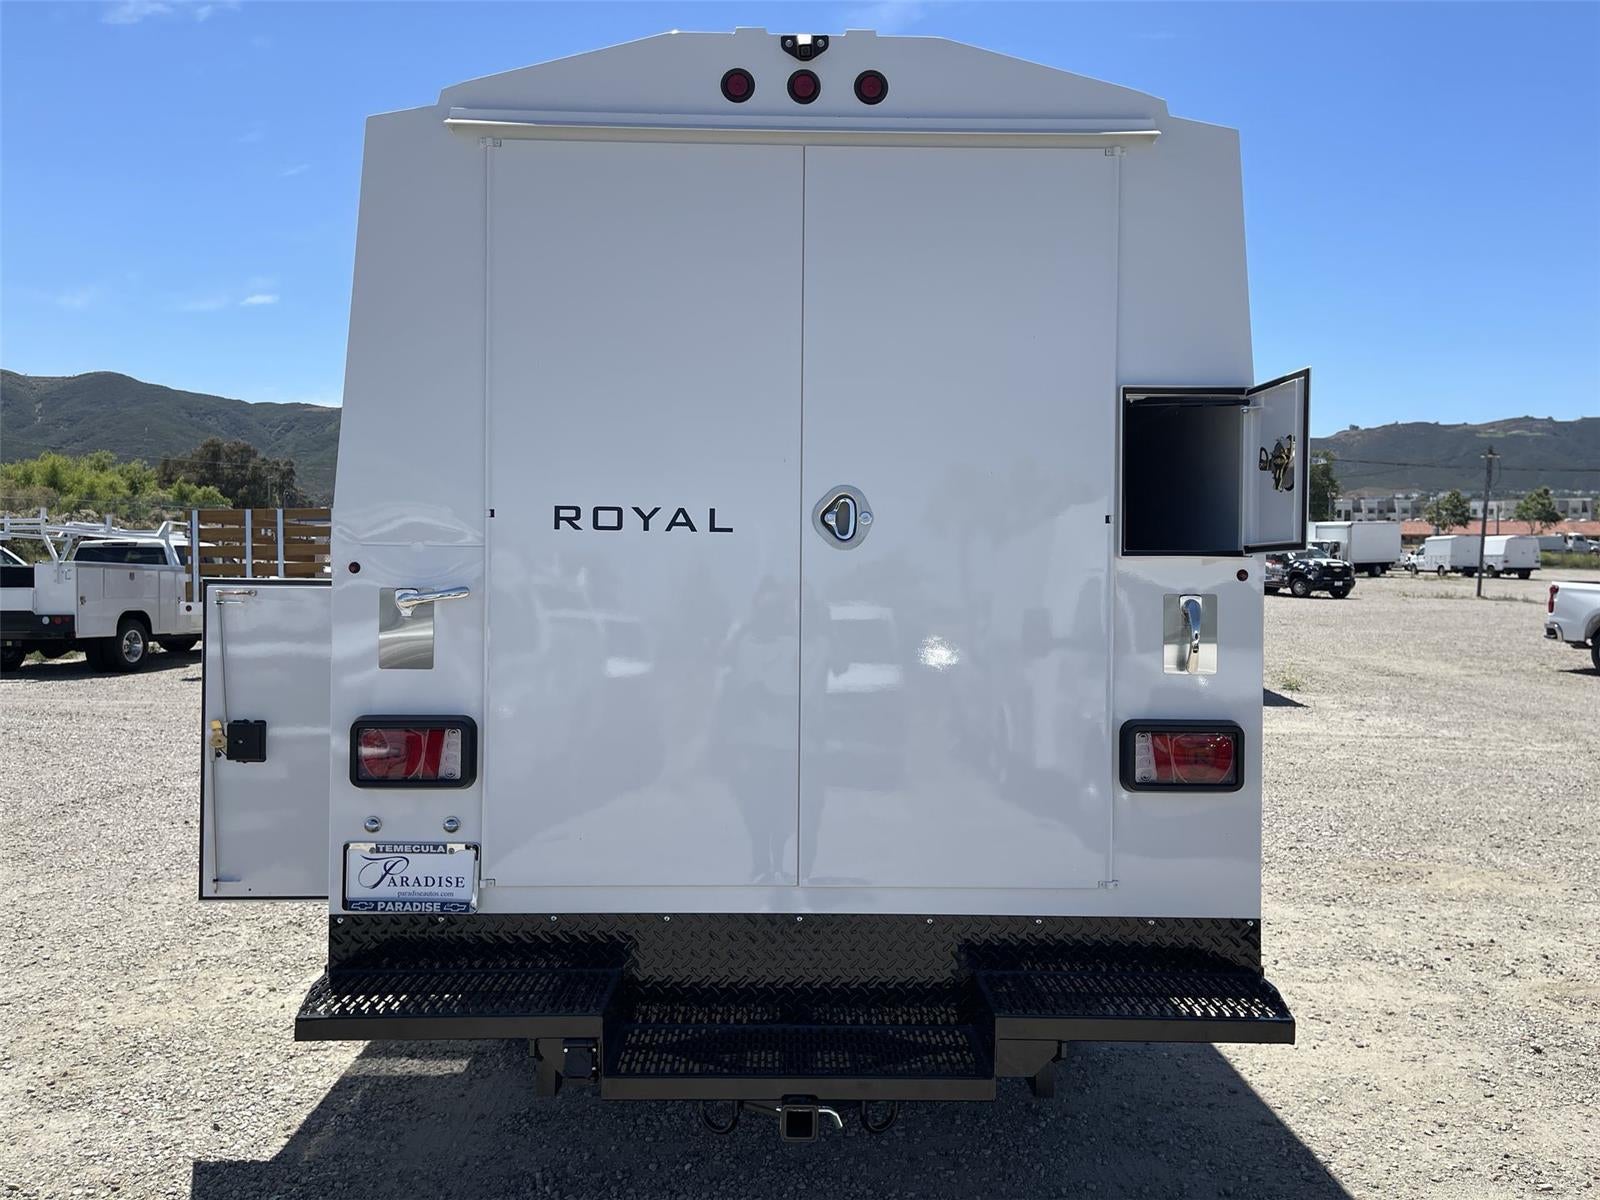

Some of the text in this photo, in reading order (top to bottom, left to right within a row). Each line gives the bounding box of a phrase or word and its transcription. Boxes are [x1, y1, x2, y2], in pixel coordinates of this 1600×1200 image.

[554, 505, 734, 533] ROYAL
[377, 844, 446, 853] TEMECULA
[397, 890, 454, 898] paradiseautos.com
[377, 901, 441, 912] PARADISE
